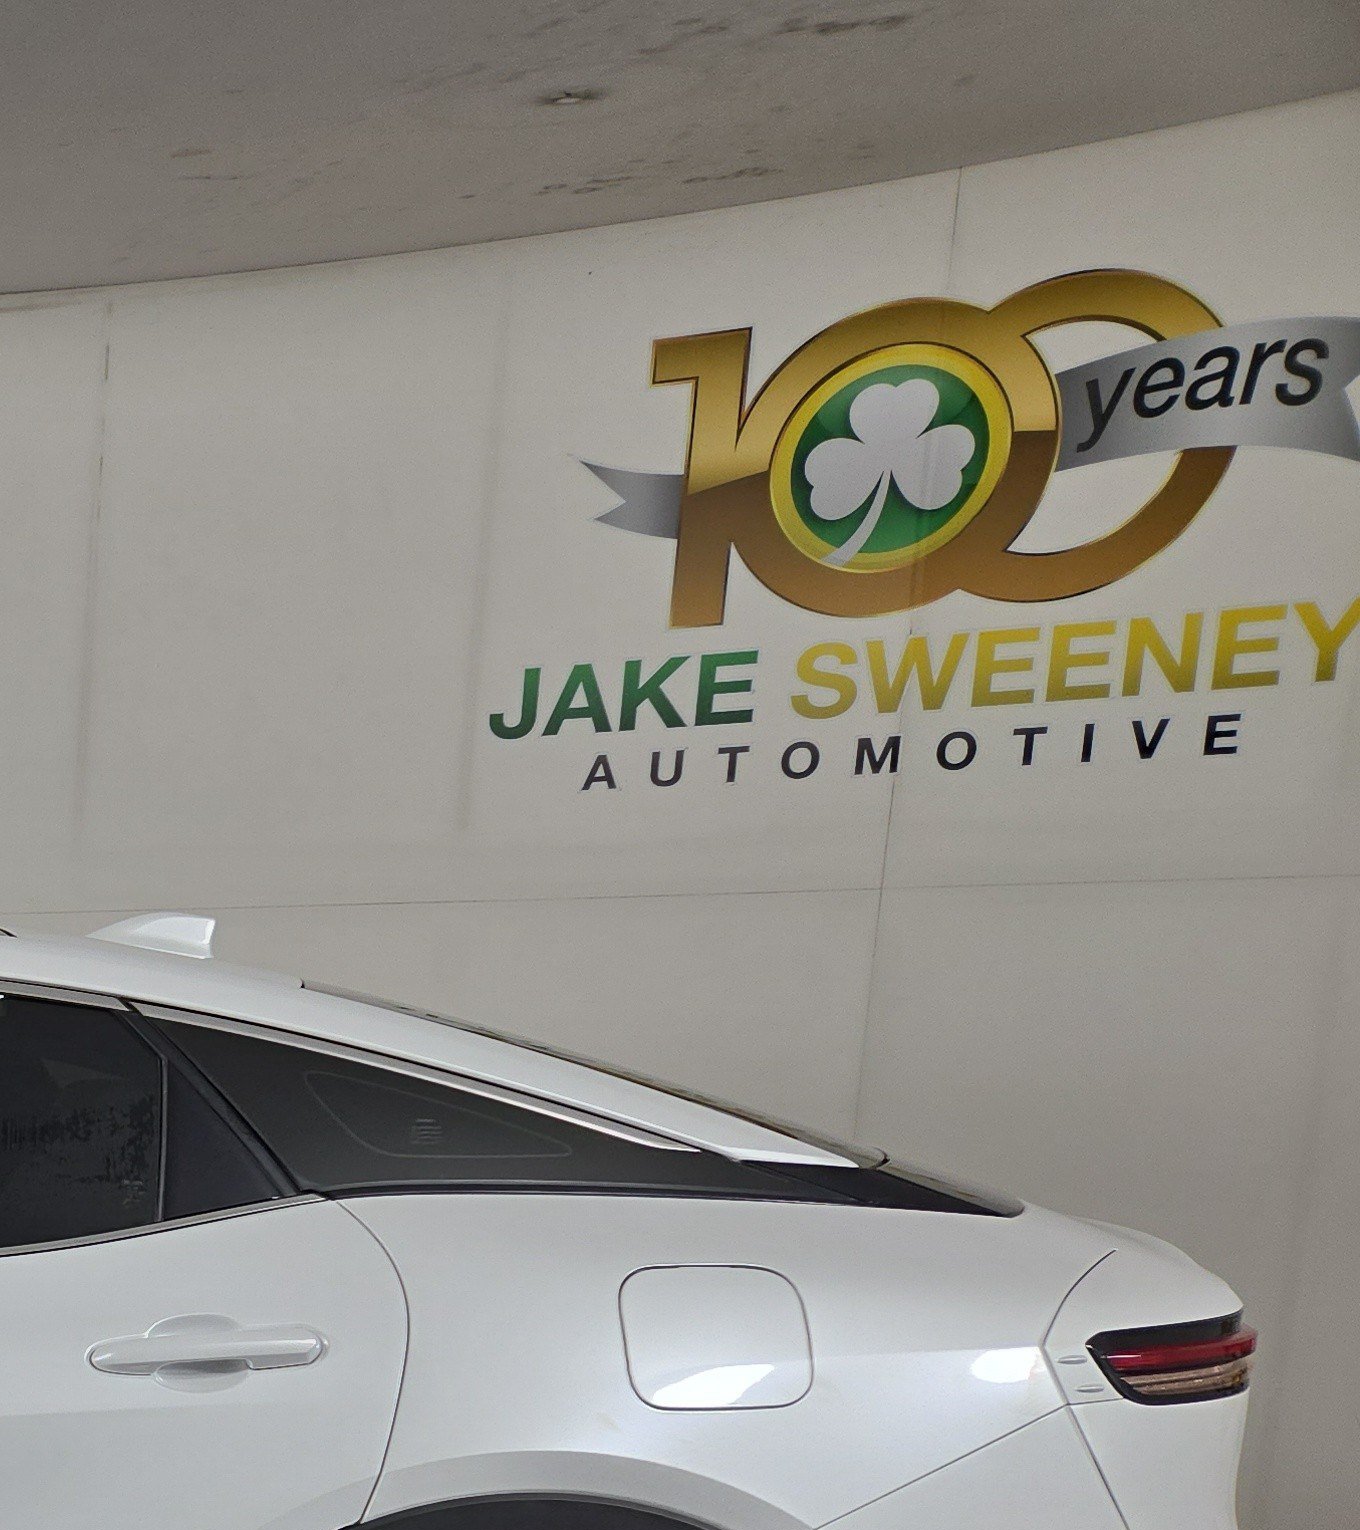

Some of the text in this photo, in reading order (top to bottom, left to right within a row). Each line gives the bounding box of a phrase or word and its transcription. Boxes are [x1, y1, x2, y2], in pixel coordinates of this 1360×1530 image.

[1076, 335, 1330, 453] years
[488, 600, 1360, 740] JAKE SWEENEY
[581, 712, 1242, 791] AUTOMOTIVE
